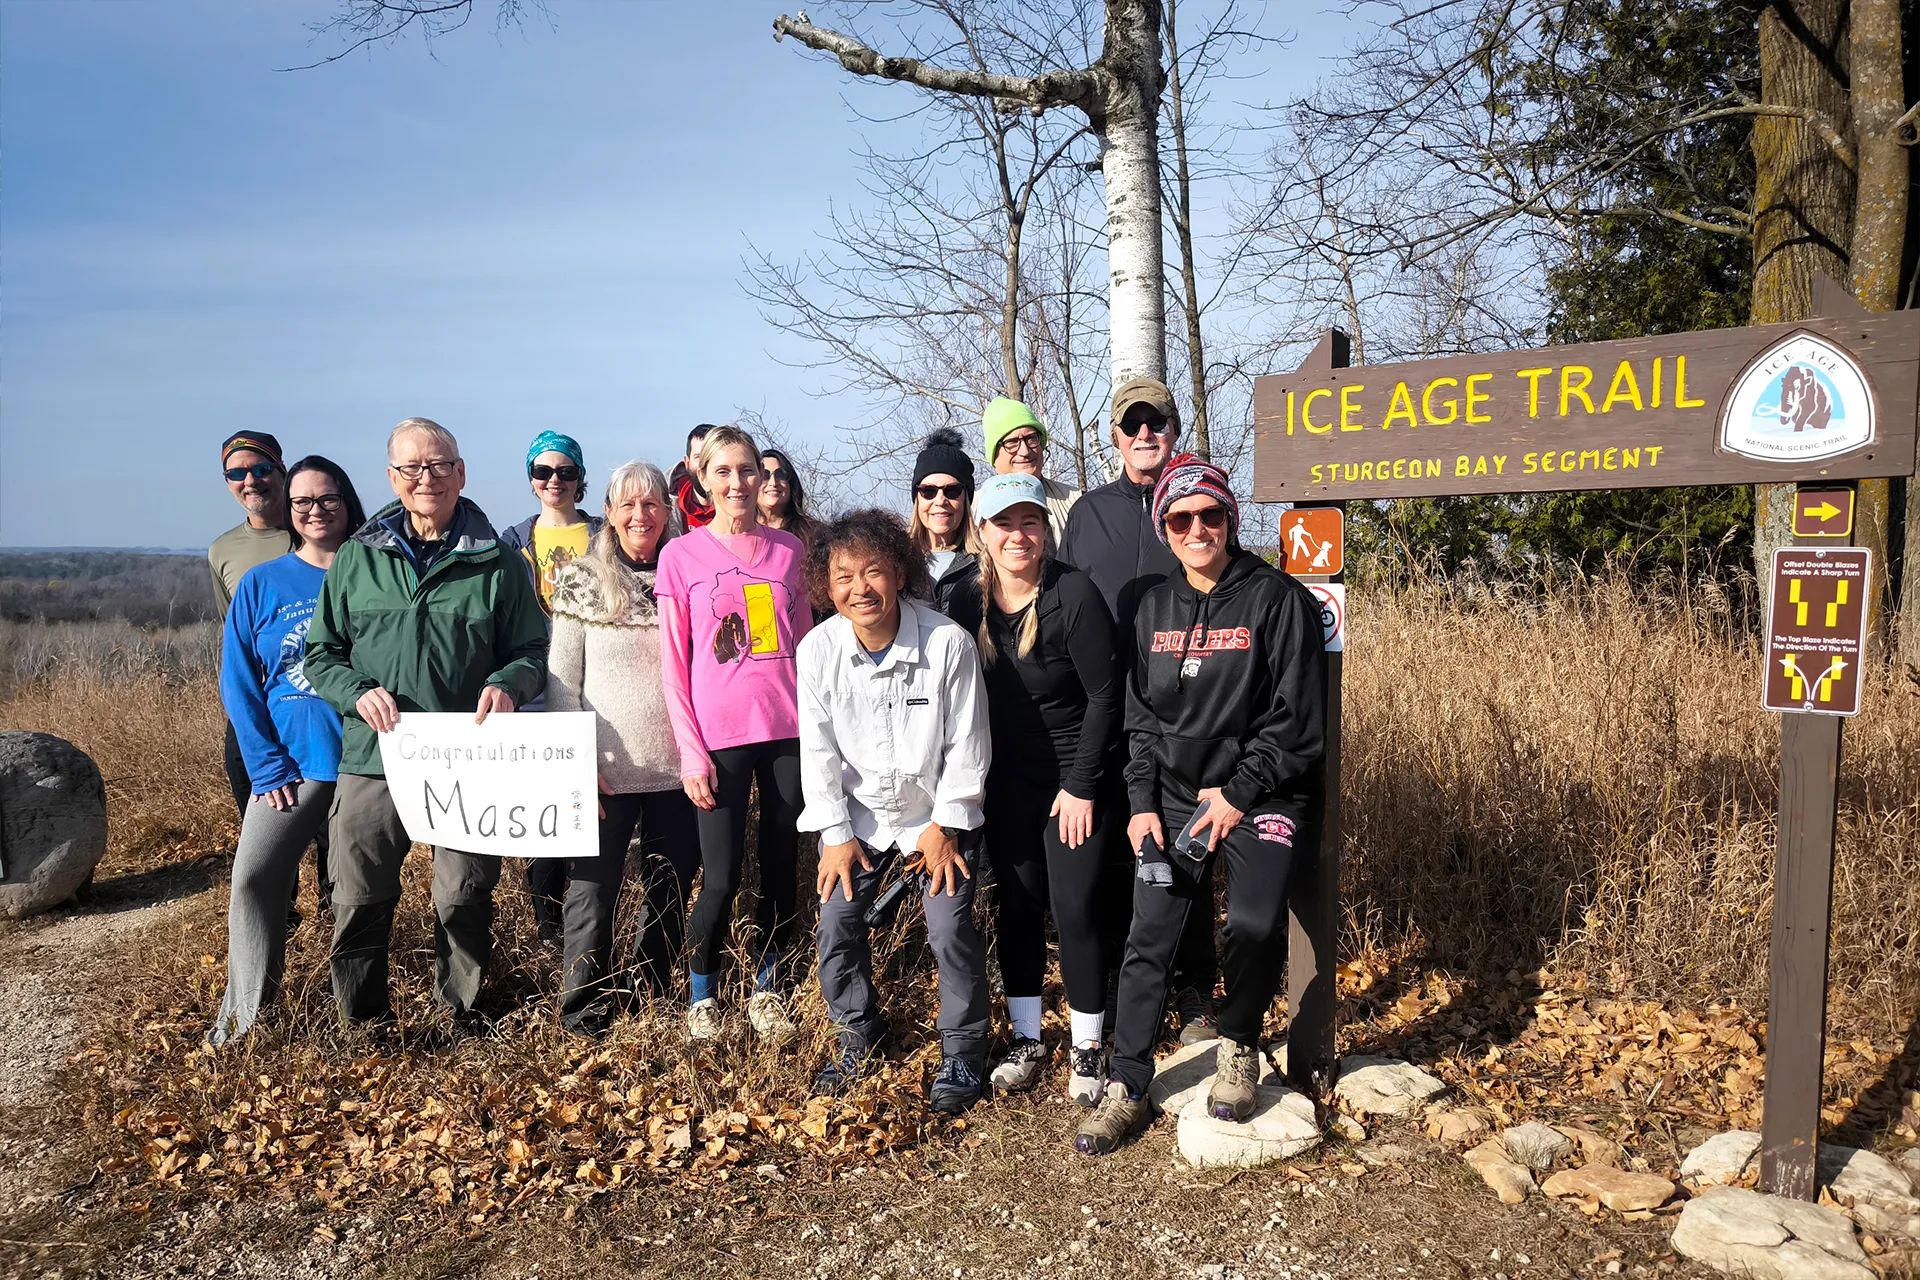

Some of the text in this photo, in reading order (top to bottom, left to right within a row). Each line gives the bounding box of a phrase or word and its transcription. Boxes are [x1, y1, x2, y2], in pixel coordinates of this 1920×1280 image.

[1764, 350, 1840, 376] ICE AGE
[1286, 355, 1705, 436] ICE AGE TRAIL
[1744, 434, 1848, 452] NATIONAL SCENIC TRAIL
[1310, 446, 1663, 483] STURGEON BAY SEGMENT
[1821, 569, 1843, 577] Sharp
[283, 607, 316, 621] Janu
[1785, 643, 1817, 651] Direction
[1828, 644, 1841, 652] The
[1842, 645, 1858, 653] Turn
[1822, 637, 1856, 645] Indicates
[399, 733, 575, 769] Congratulations
[424, 780, 558, 839] Masa
